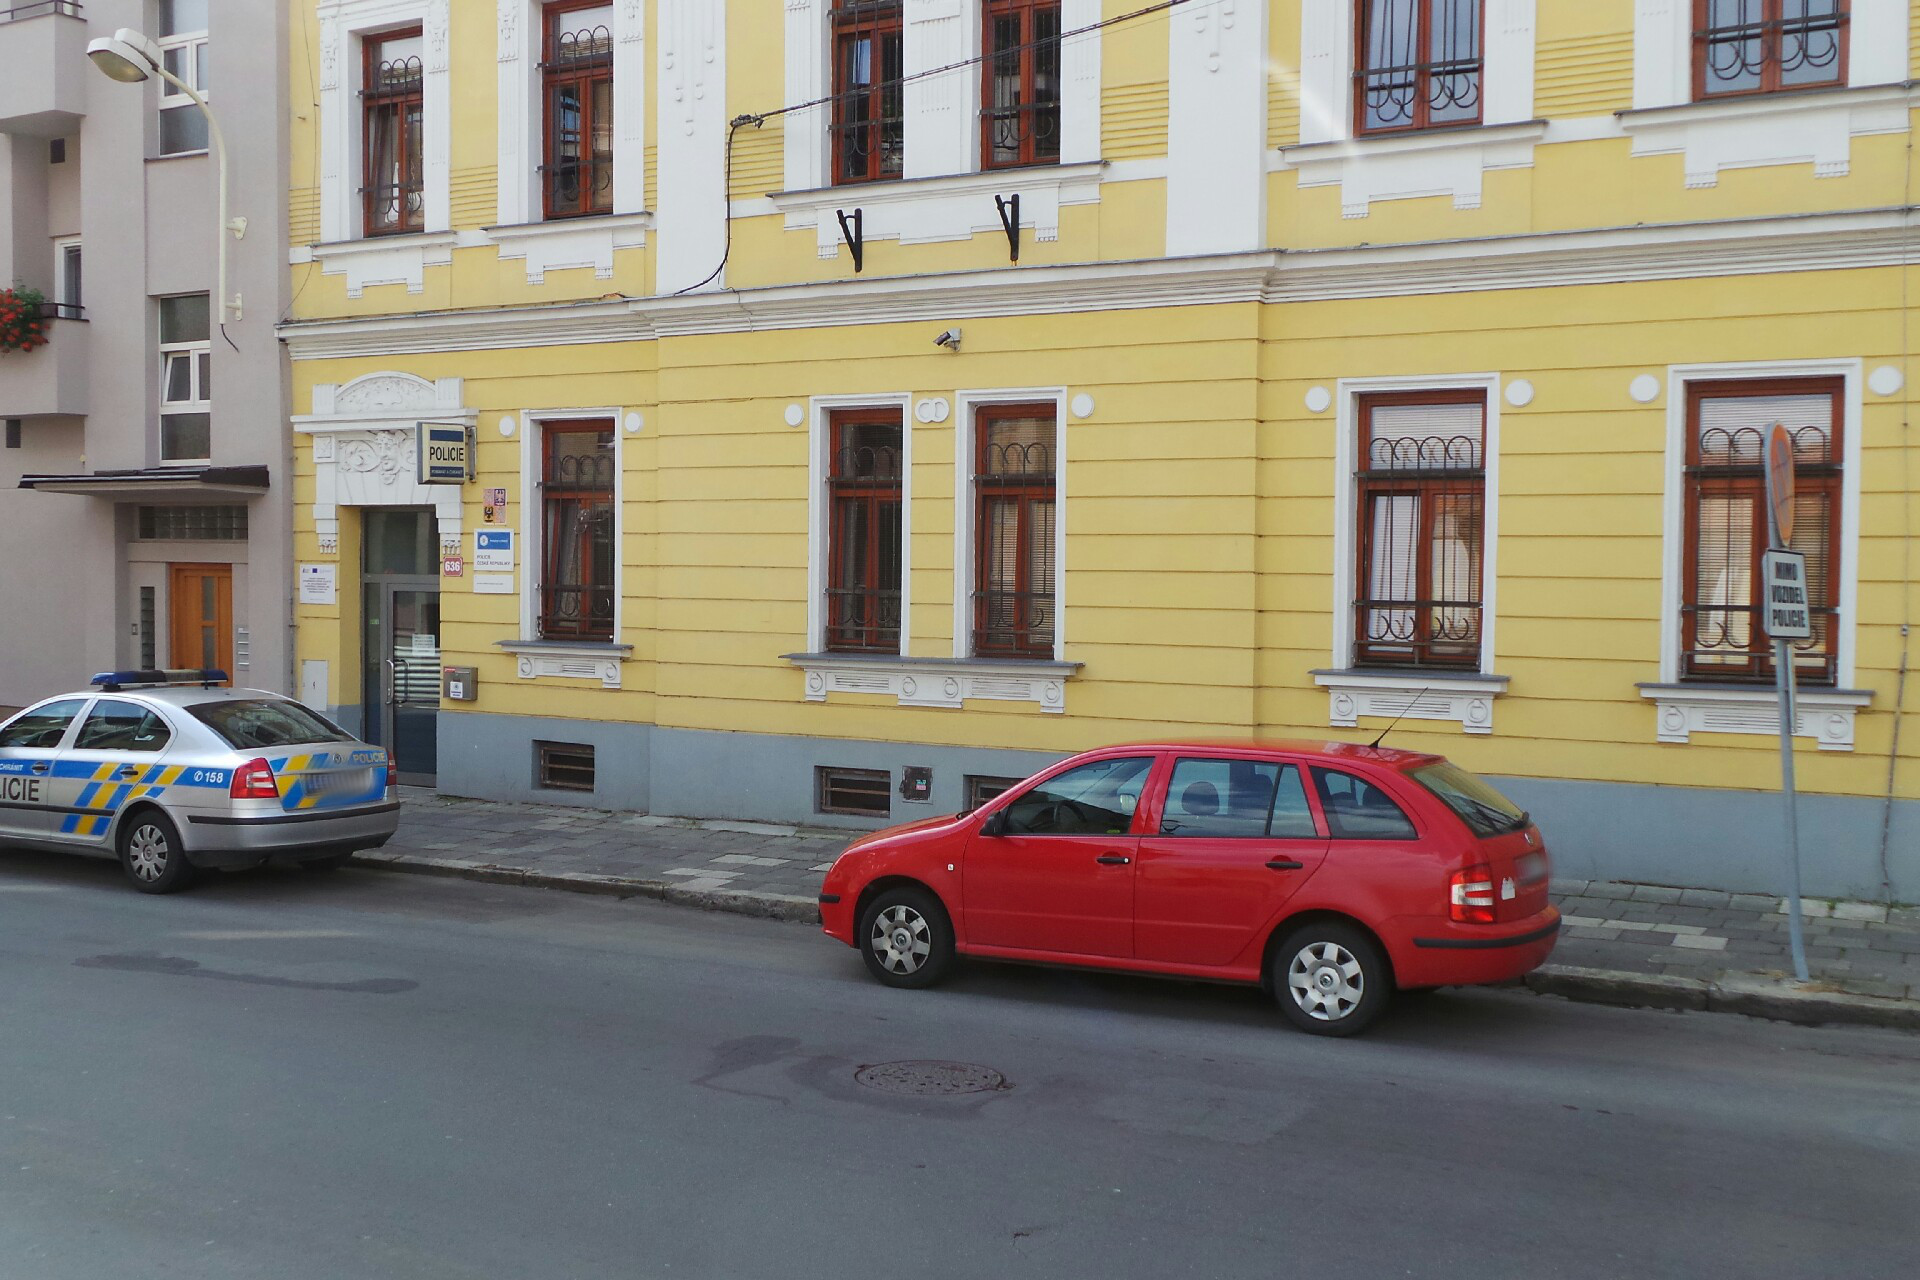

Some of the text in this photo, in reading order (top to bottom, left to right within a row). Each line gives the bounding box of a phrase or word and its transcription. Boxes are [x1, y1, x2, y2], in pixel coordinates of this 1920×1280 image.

[430, 446, 464, 461] POLICIE
[445, 561, 461, 572] 636
[1775, 561, 1798, 581] MIMO
[1771, 585, 1805, 604] VOZIDEL
[1772, 609, 1806, 628] POLICIE
[352, 752, 386, 763] POLICIE
[205, 772, 224, 784] 158
[0, 777, 40, 802] ICIE
